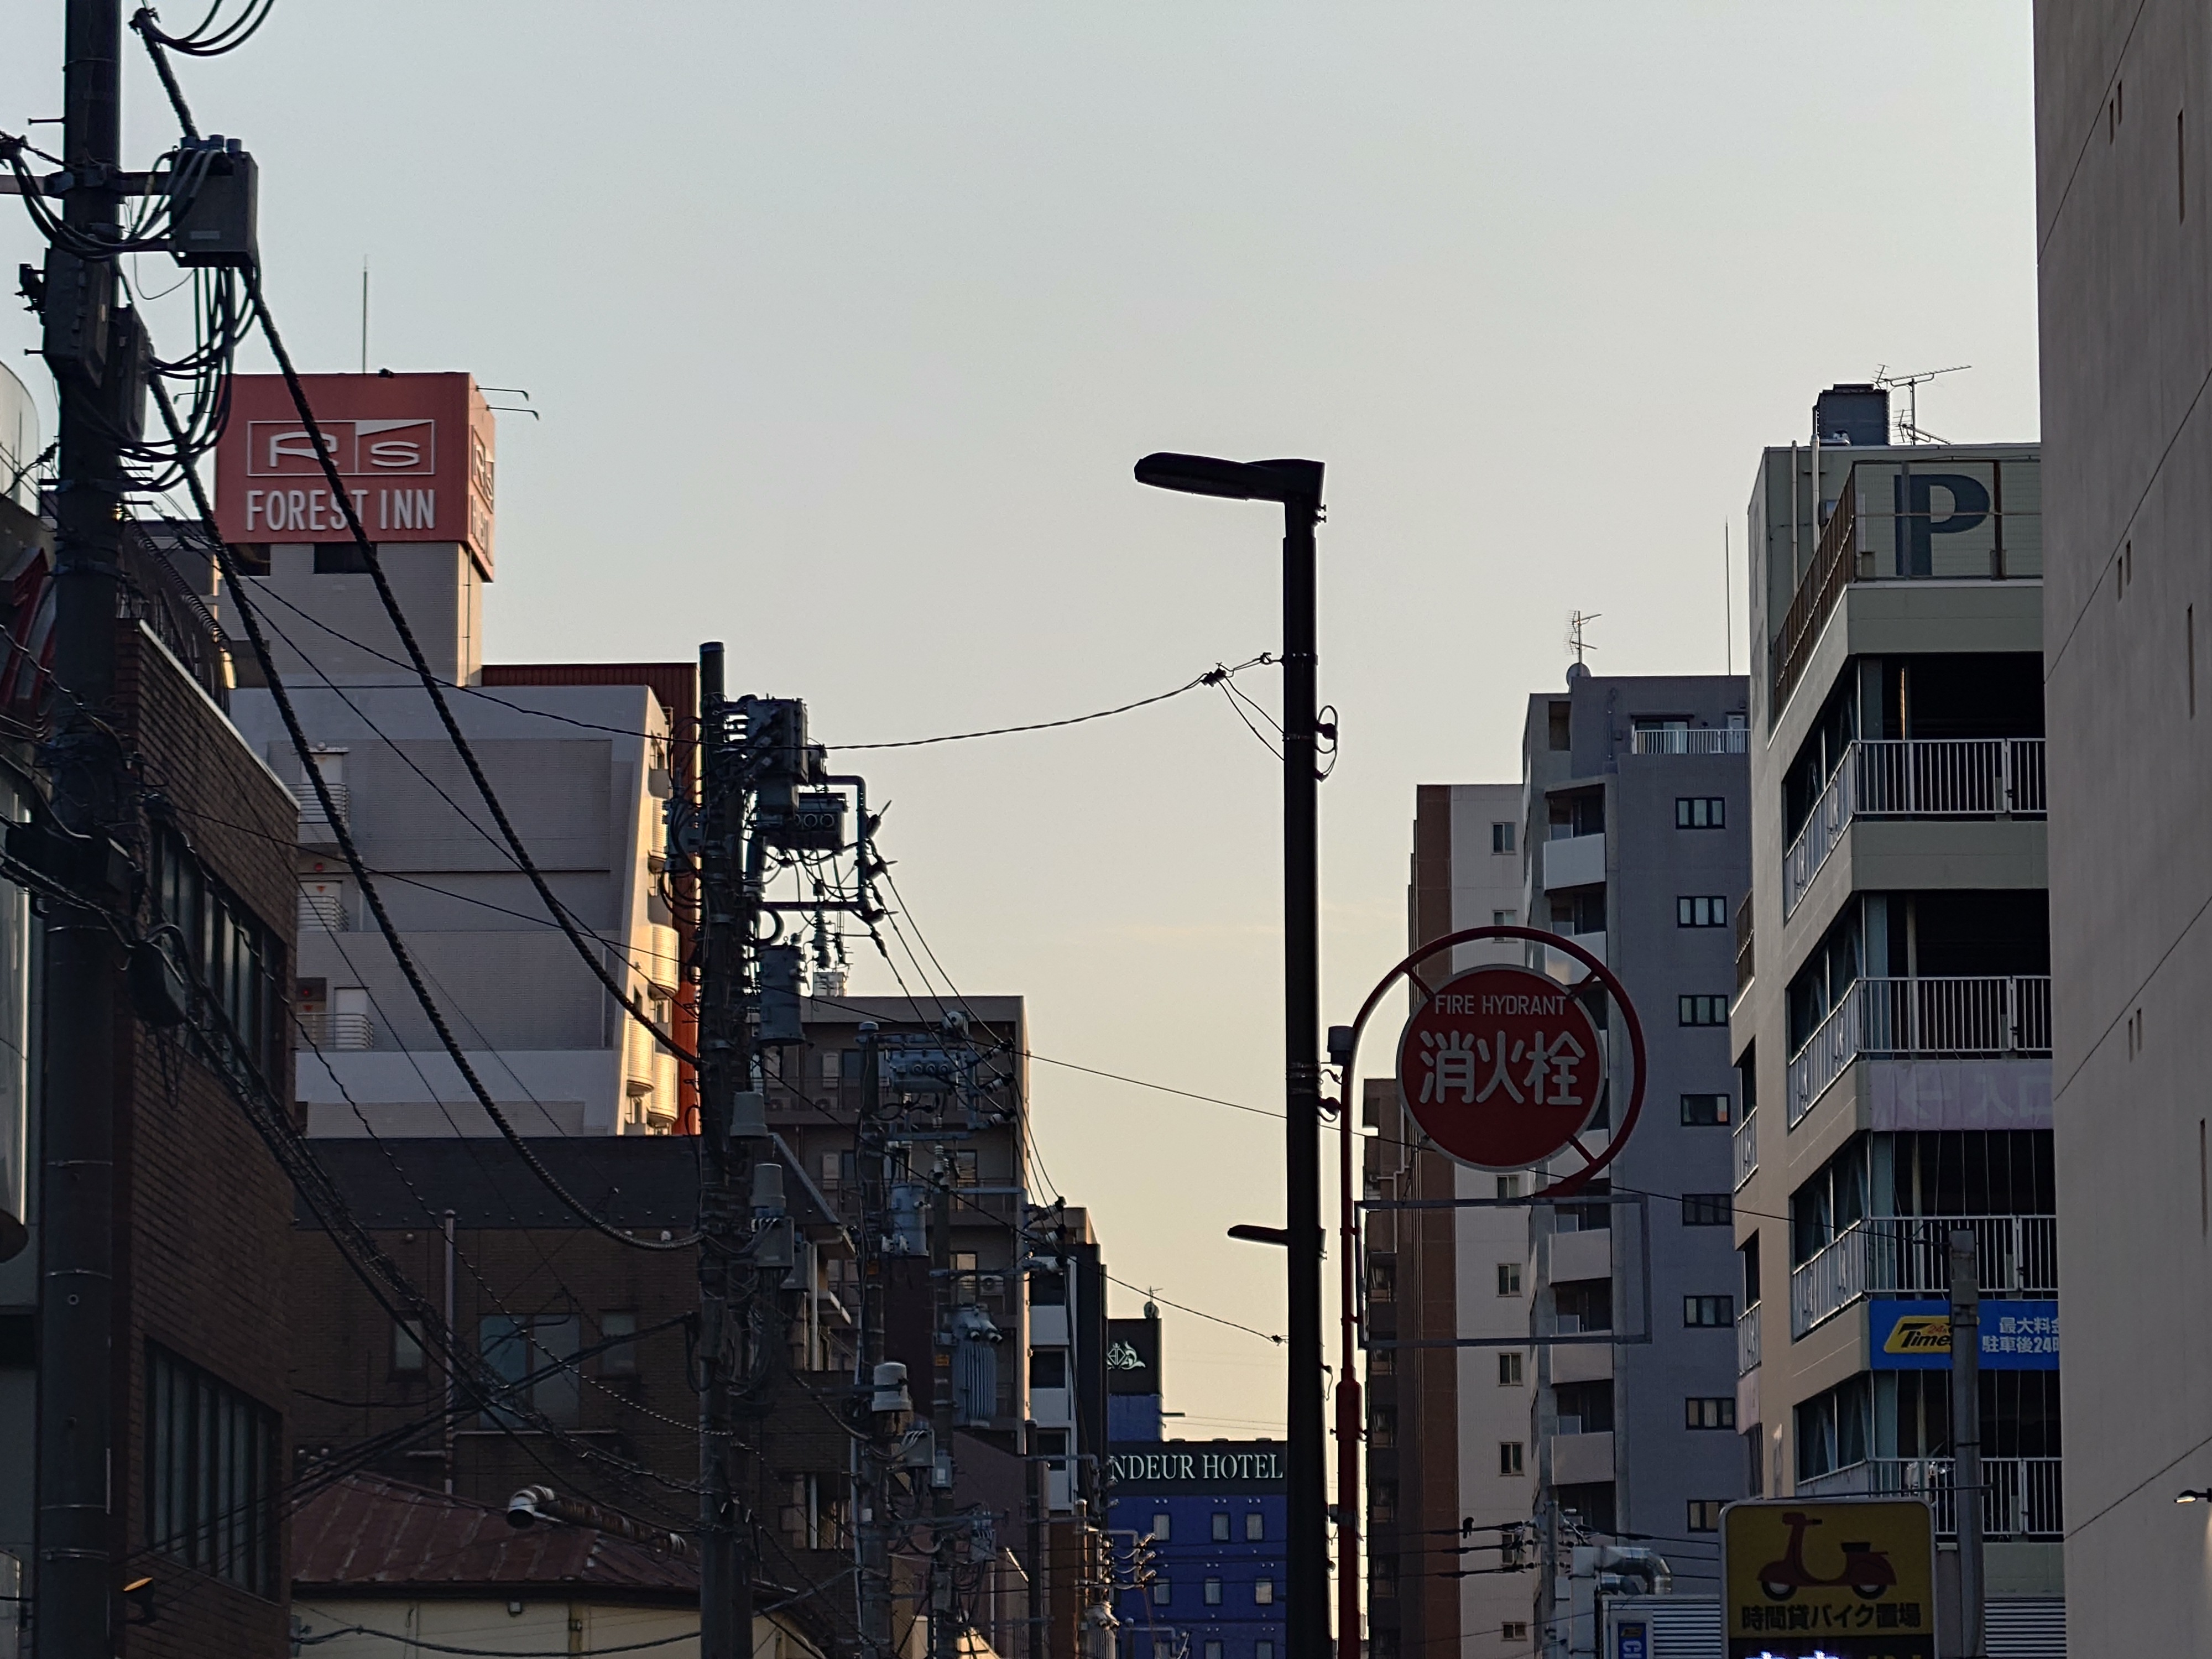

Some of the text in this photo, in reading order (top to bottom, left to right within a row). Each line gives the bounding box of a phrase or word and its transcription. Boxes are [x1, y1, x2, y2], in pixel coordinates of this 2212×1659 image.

[246, 488, 436, 532] FOREST INN
[1893, 474, 1990, 576] P
[1435, 994, 1567, 1015] FIRE HYDRANT
[1419, 1030, 1586, 1105] 消火栓
[1898, 1323, 1952, 1348] Time
[1203, 1454, 1284, 1480] HOTEL
[1742, 1603, 1921, 1630] 時間貸バイク置場
